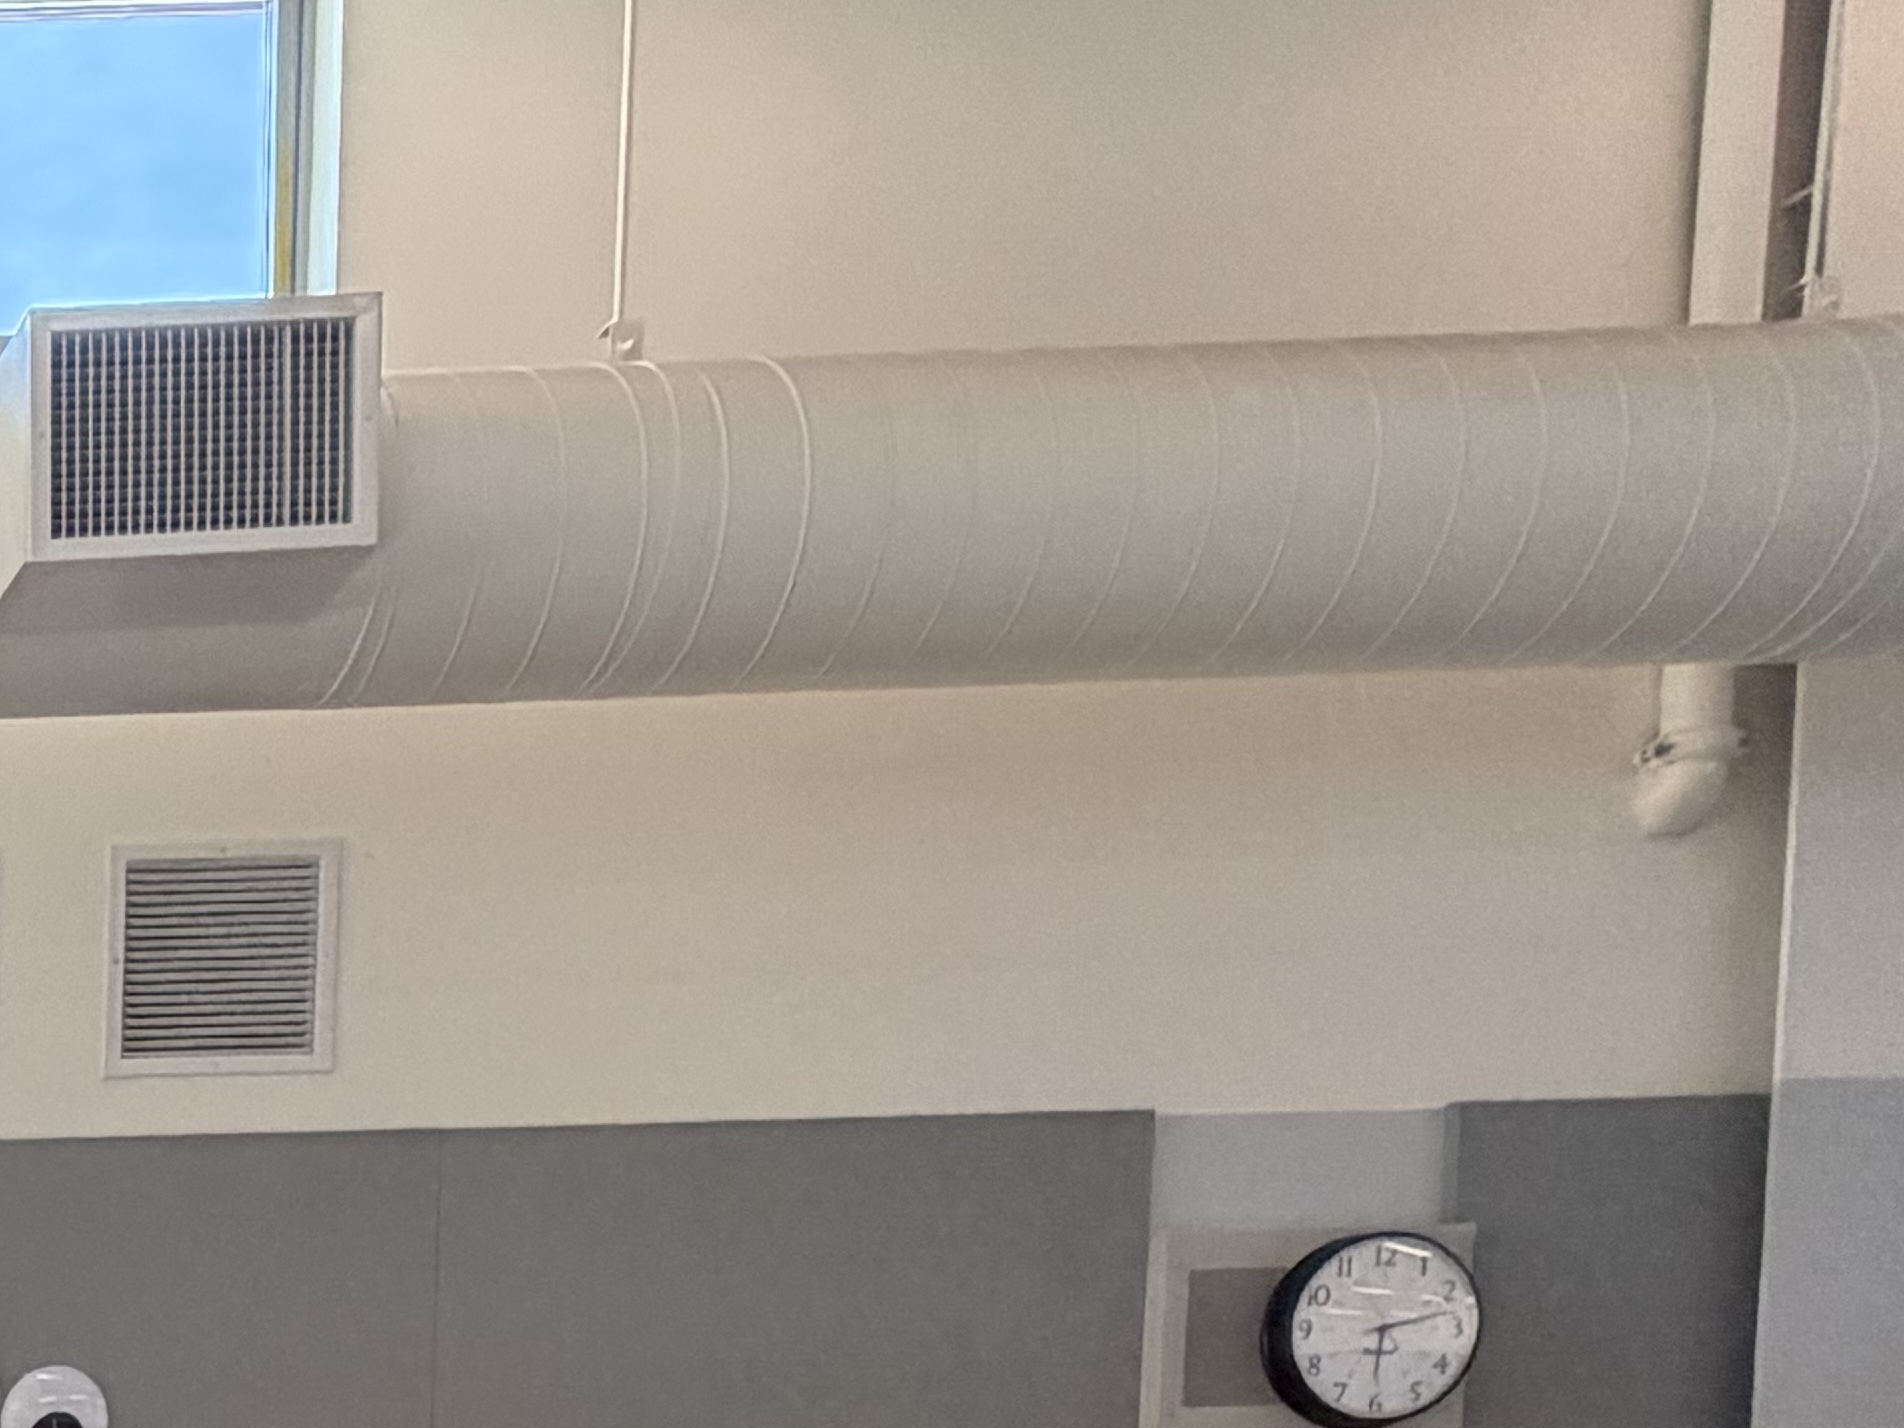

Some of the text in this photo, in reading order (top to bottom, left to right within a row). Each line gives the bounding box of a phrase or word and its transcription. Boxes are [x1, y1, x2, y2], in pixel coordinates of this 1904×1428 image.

[1336, 1255, 1352, 1279] 11
[1374, 1244, 1397, 1268] 12
[1419, 1255, 1429, 1277] 1
[1442, 1280, 1457, 1303] 2
[1298, 1318, 1313, 1341] 9
[1448, 1315, 1464, 1339] 3
[1306, 1354, 1322, 1377] 8
[1431, 1352, 1449, 1376] 4
[1332, 1381, 1348, 1403] 7
[1409, 1380, 1423, 1402] 5
